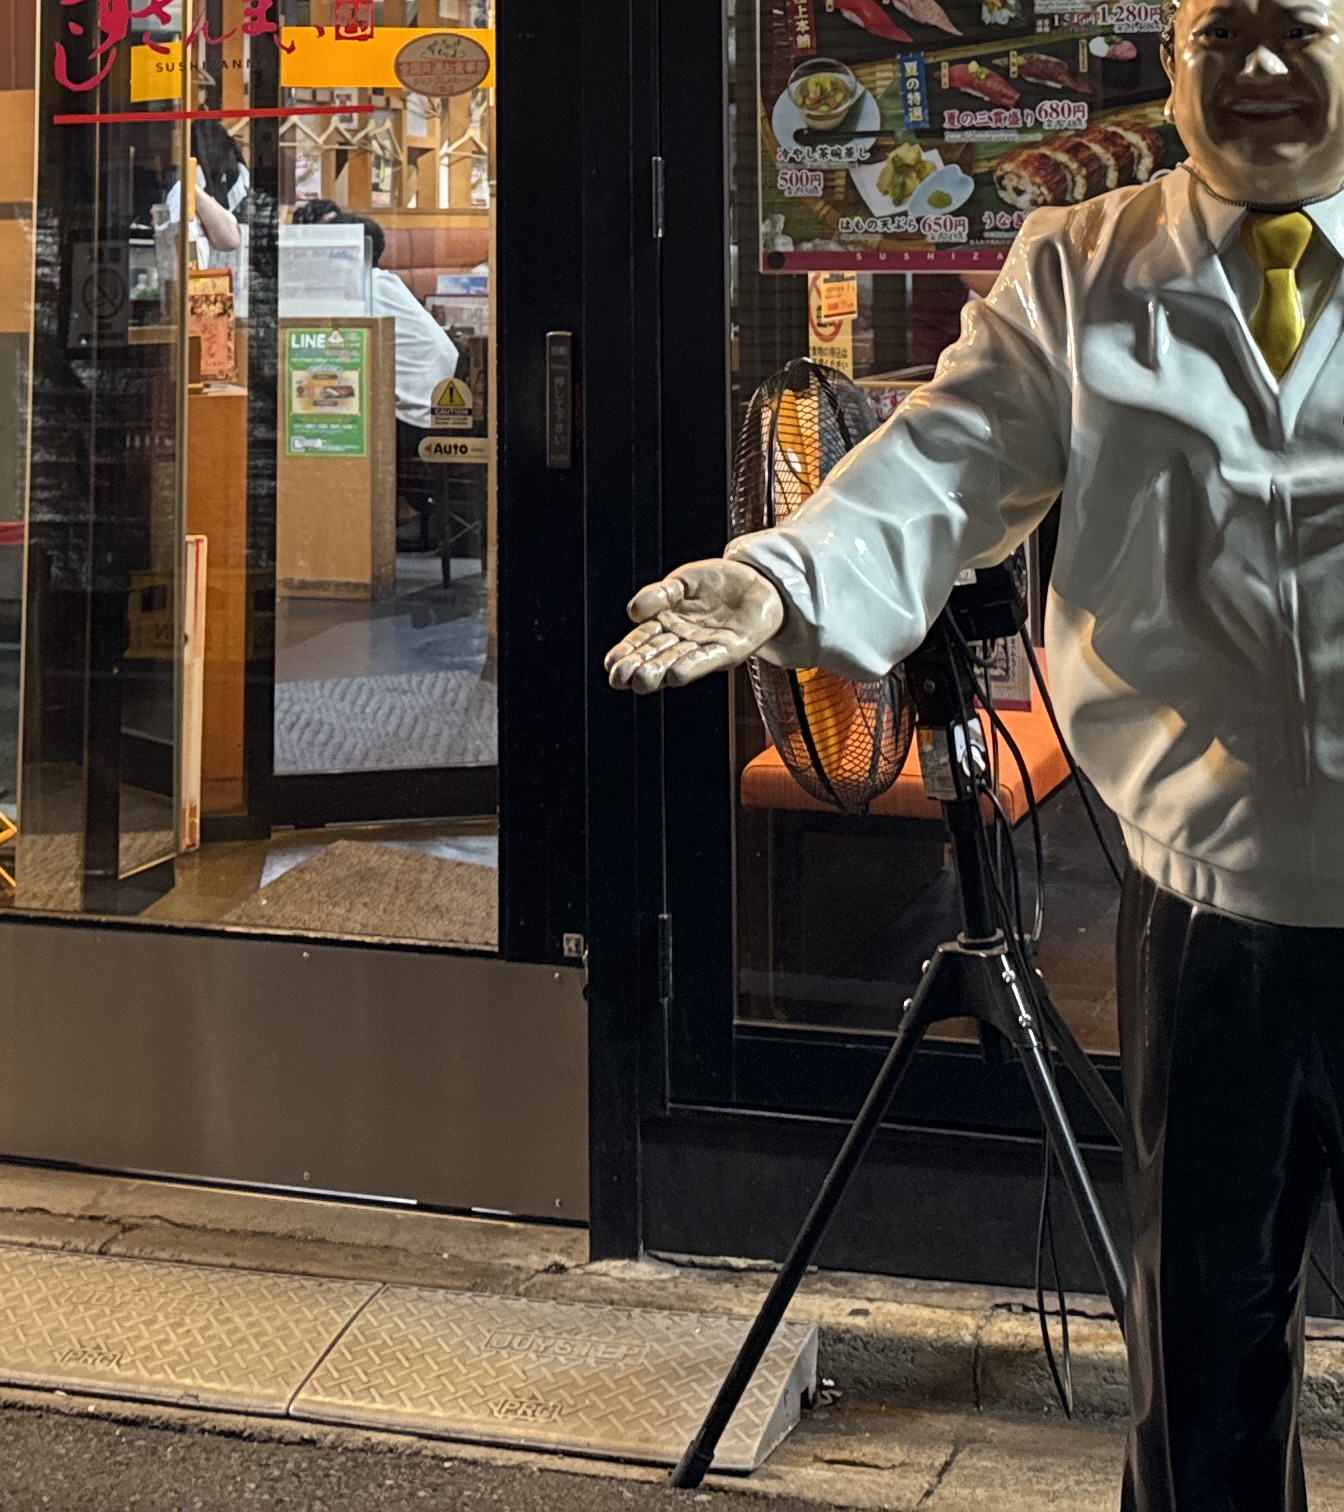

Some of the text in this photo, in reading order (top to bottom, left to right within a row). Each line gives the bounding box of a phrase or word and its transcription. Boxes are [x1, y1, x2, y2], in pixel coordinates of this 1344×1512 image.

[1098, 5, 1162, 24] 1,280円
[904, 60, 924, 121] 夏の特選
[945, 110, 1035, 127] 夏の三貫盛り
[1038, 101, 1087, 120] 680円
[778, 147, 869, 160] 冷やし茶碗蒸し
[778, 171, 822, 188] 500円
[840, 218, 918, 232] はもの天ぷら
[920, 216, 967, 233] 650円
[291, 333, 326, 349] LINE
[433, 443, 468, 455] Auto
